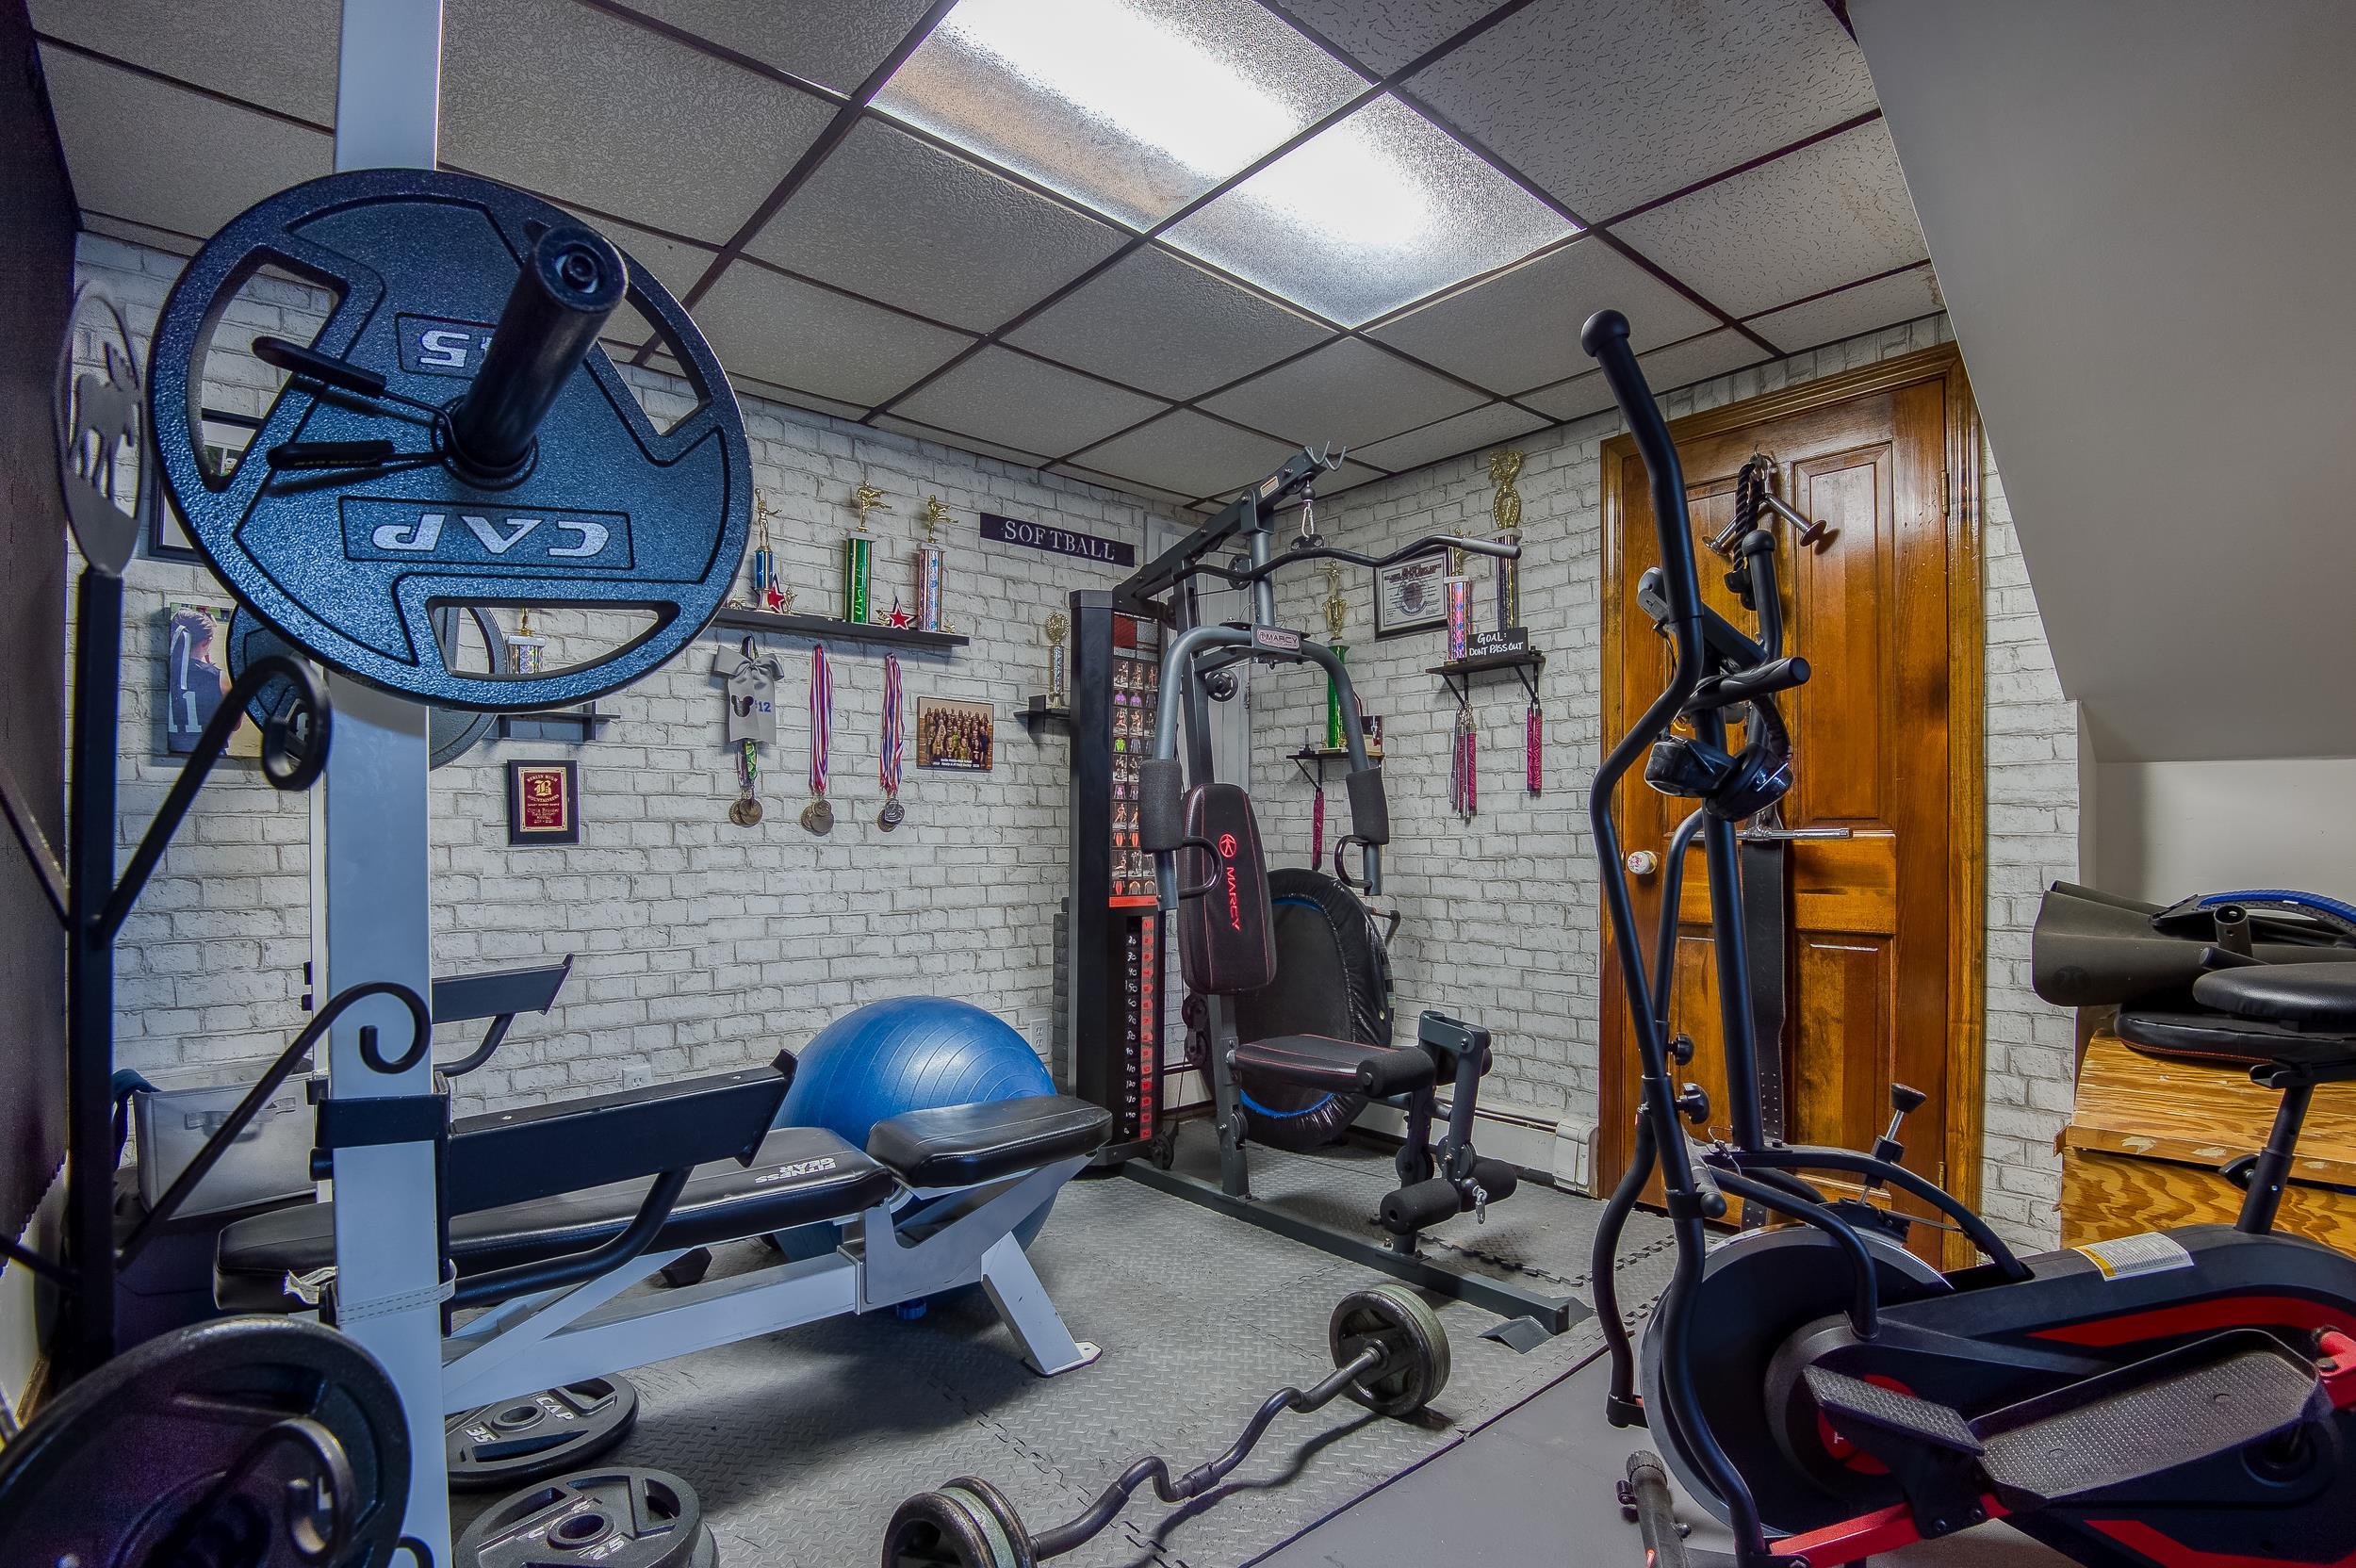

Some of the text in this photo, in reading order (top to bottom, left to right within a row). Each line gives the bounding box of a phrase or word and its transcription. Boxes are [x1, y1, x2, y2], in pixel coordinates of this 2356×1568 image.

[371, 514, 610, 558] CAP
[1005, 520, 1115, 561] SOFTBALL
[1266, 632, 1298, 645] MARCY
[1477, 632, 1507, 645] GOAL:
[1469, 642, 1524, 656] DONT PASS OUT
[534, 780, 552, 796] B
[1227, 867, 1240, 931] MARCY
[755, 1161, 837, 1184] FITNESS
[779, 1157, 835, 1174] GEAR
[535, 1396, 575, 1421] CAP
[465, 1427, 497, 1444] 35
[588, 1538, 625, 1560] 25
